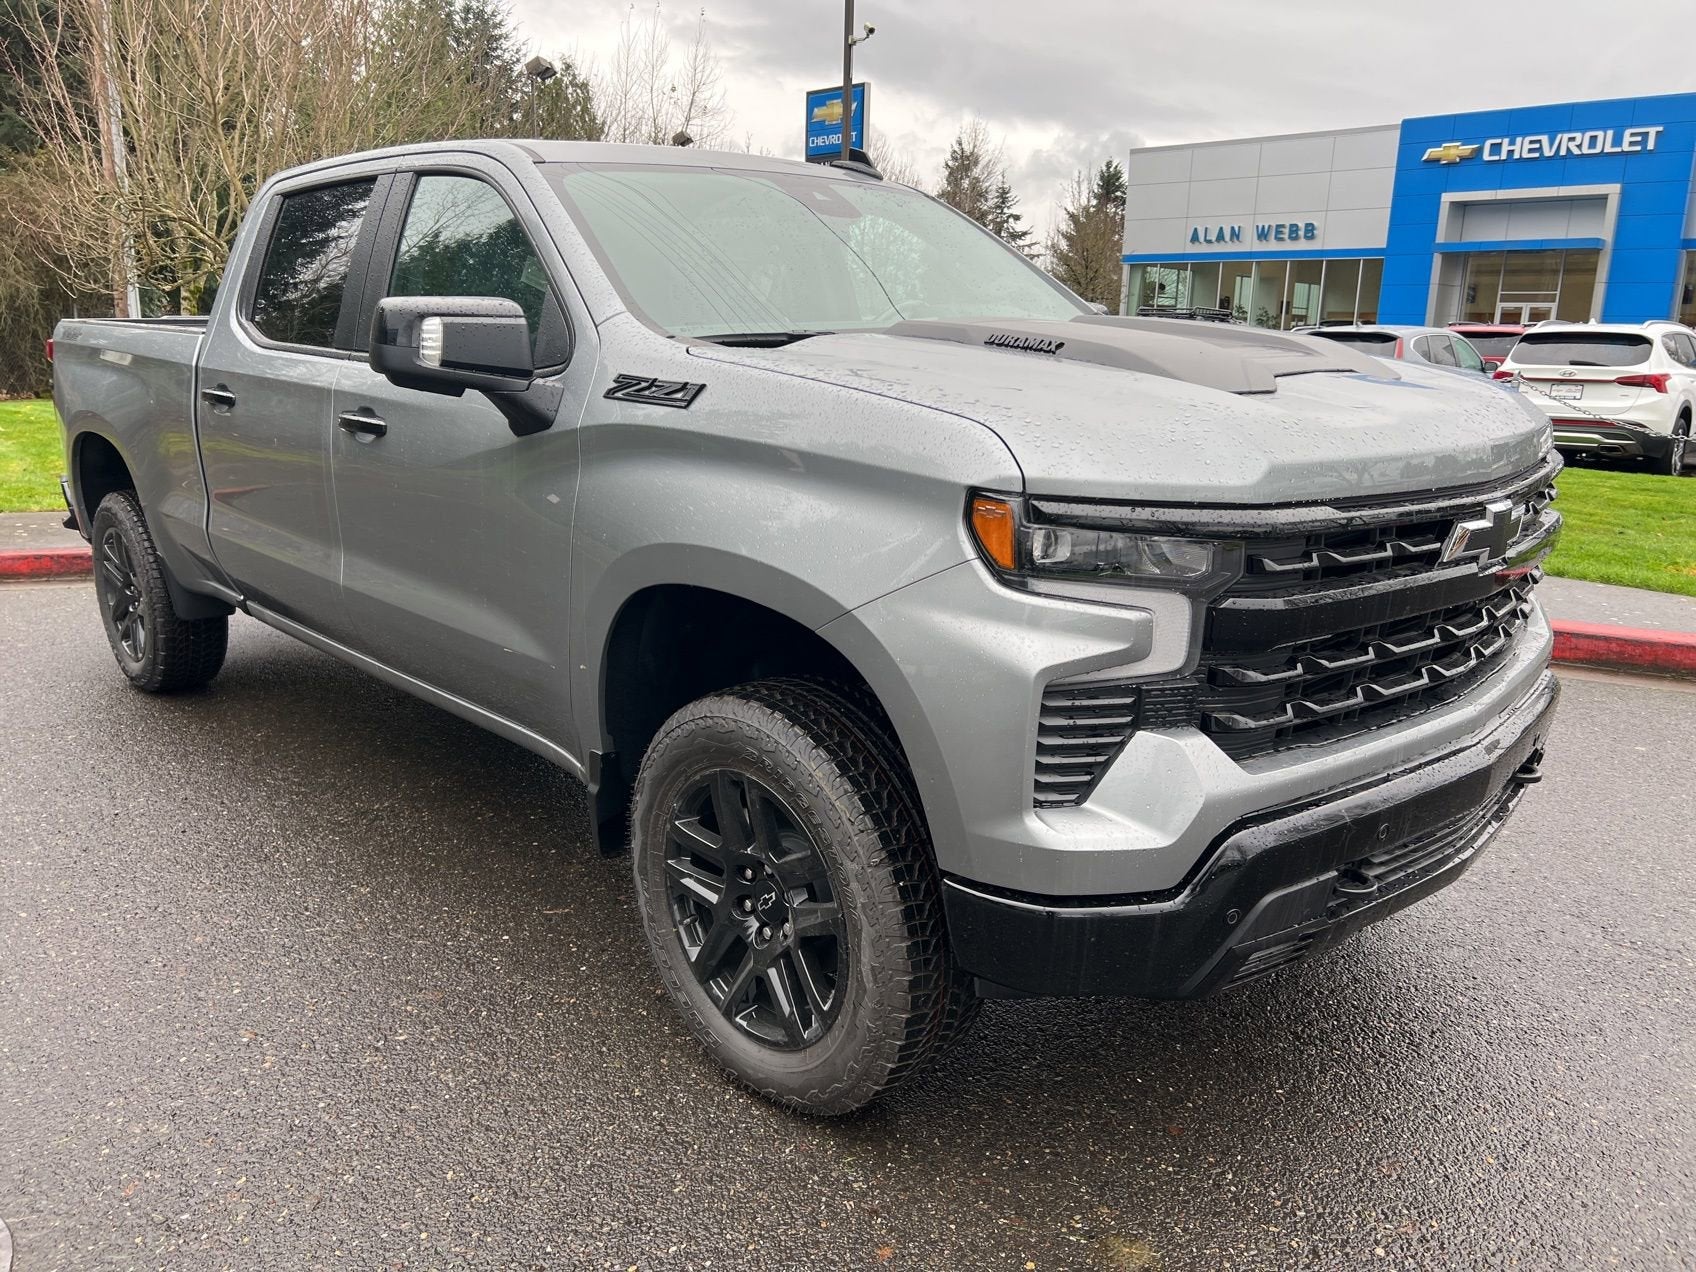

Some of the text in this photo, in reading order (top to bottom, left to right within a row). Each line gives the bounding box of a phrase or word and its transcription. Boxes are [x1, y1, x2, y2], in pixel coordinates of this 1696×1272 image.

[809, 131, 857, 147] CHEVROT
[1483, 126, 1664, 161] CHEVROLET
[1189, 222, 1317, 244] ALAN WEBB
[984, 334, 1065, 355] DURAMAX
[603, 374, 706, 409] Z71
